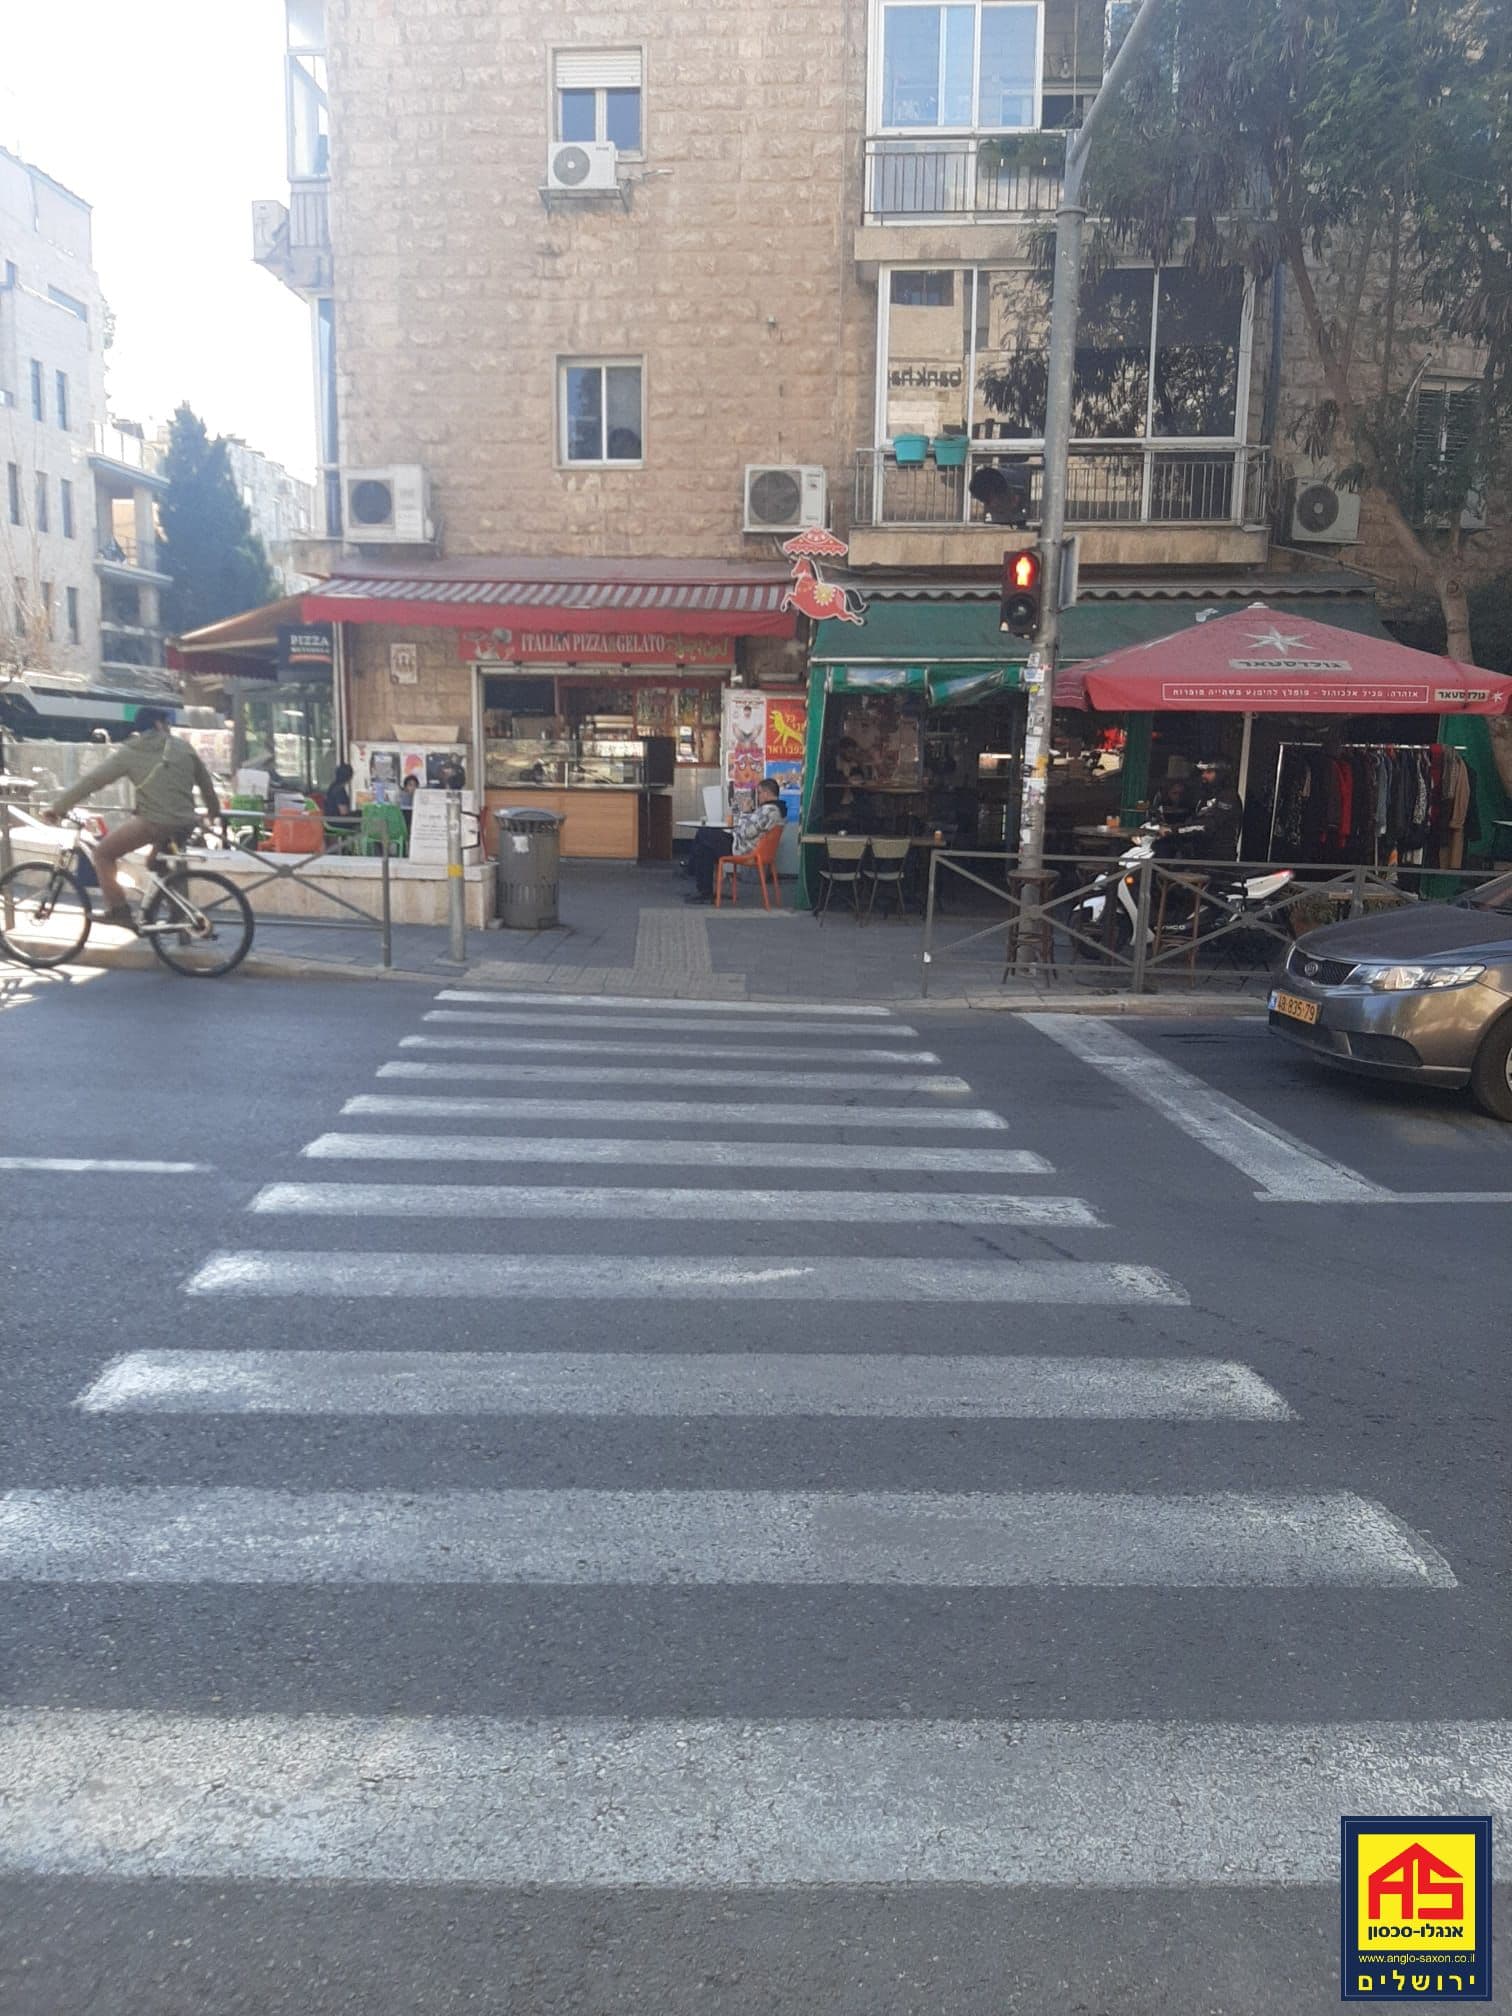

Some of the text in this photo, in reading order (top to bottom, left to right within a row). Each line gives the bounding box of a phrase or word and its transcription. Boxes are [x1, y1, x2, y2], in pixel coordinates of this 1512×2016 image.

[290, 634, 330, 646] PIZZA
[521, 631, 570, 652] ITALIAN
[573, 632, 609, 652] PIZZA
[616, 633, 665, 653] GELATO
[1238, 660, 1342, 668] גולדסטאר
[1321, 688, 1358, 697] אלכוהול
[1437, 691, 1486, 700] גולדסטאר
